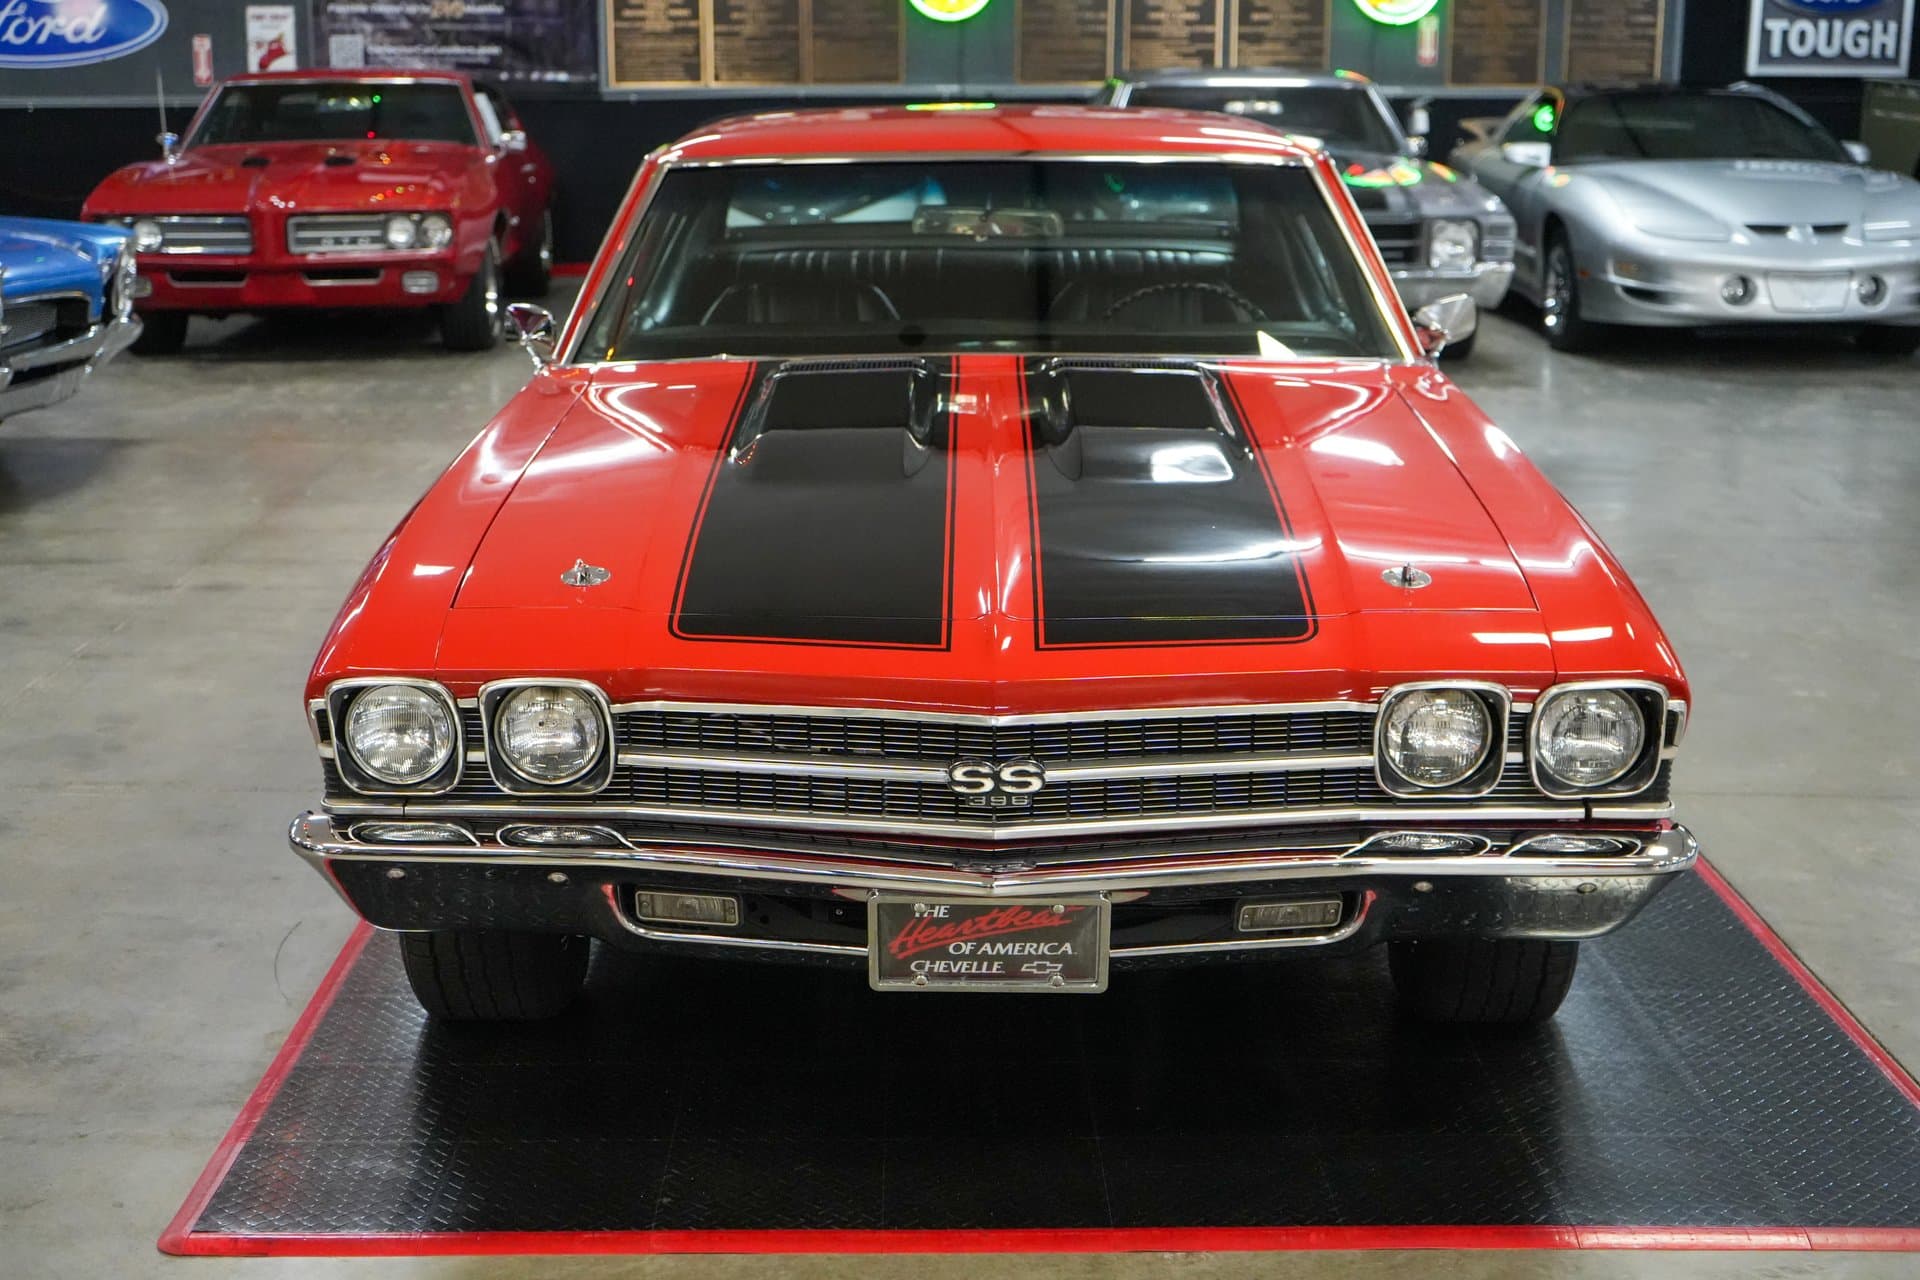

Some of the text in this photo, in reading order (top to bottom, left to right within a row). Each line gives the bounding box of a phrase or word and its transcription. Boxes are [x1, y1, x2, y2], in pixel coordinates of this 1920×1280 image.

[1764, 18, 1899, 59] TOUGH
[951, 763, 1043, 794] SS
[968, 795, 1029, 806] 396
[948, 942, 1073, 956] OF AMERICA
[910, 960, 1003, 974] CHEVELLE
